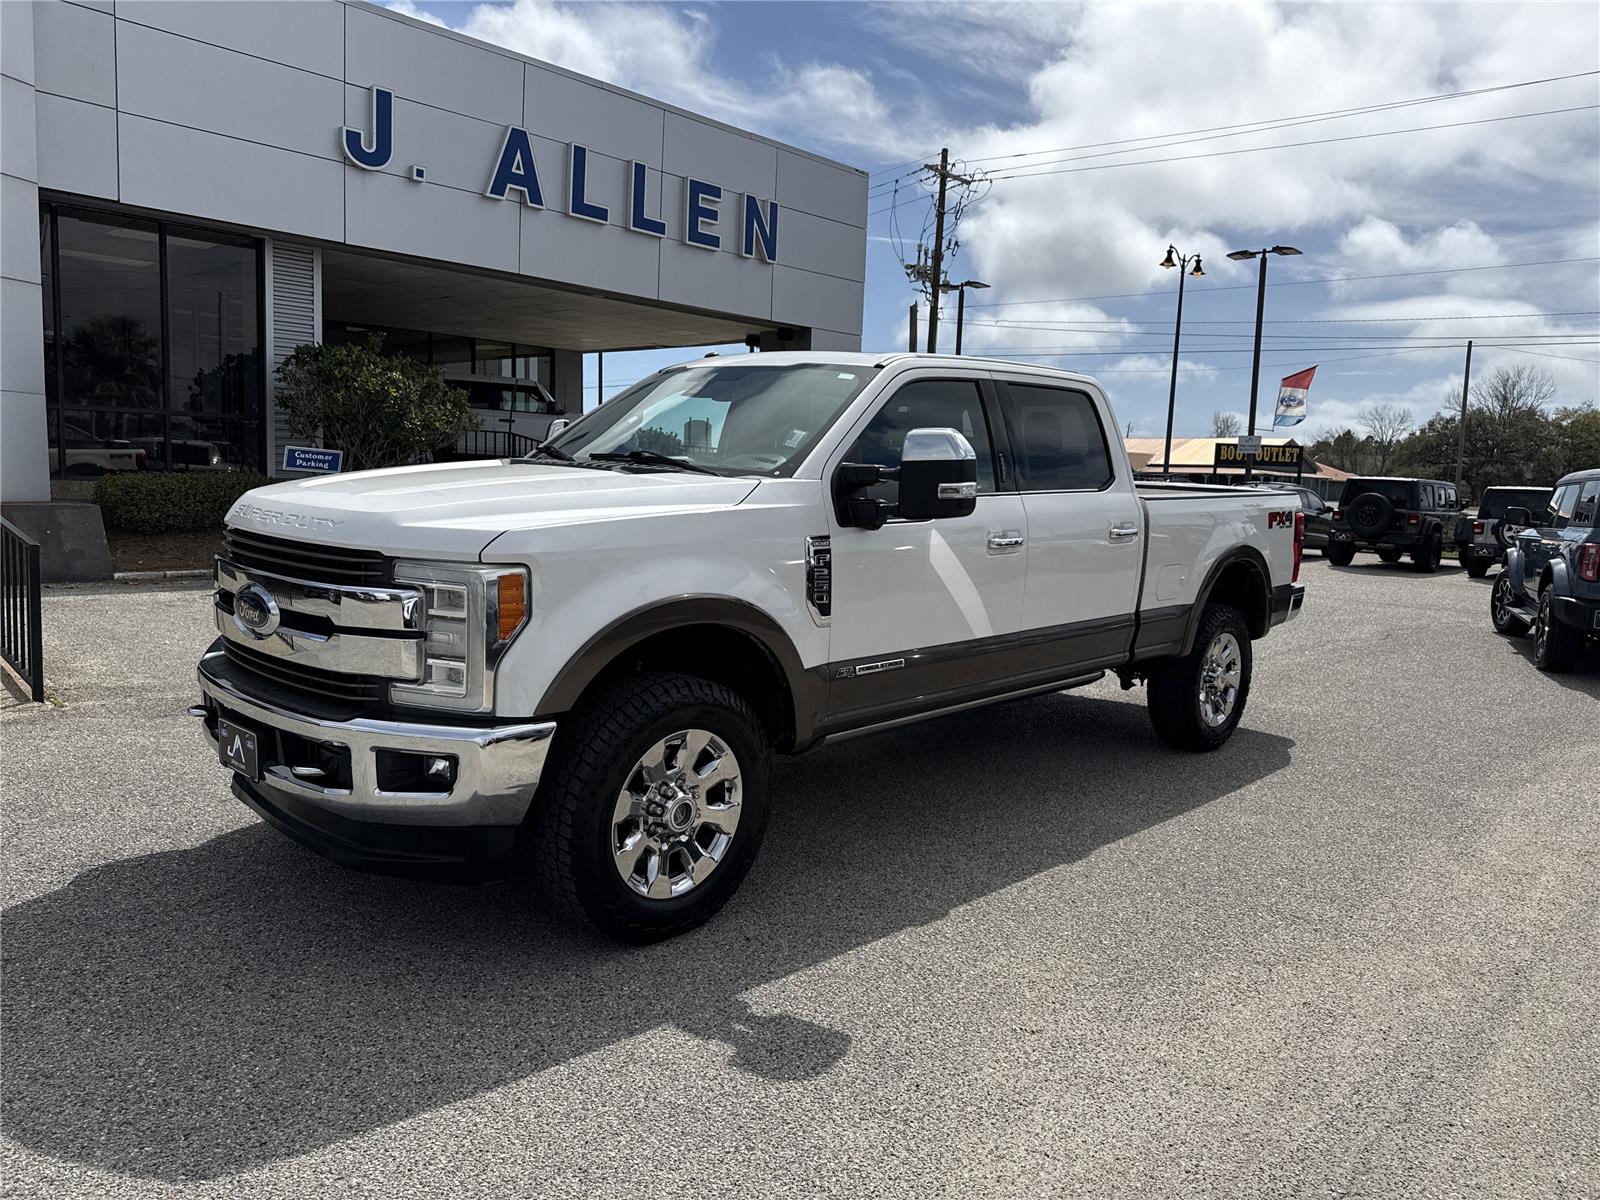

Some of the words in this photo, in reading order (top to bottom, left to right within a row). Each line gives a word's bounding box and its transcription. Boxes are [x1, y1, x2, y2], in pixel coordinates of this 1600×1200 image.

[483, 124, 781, 265] ALLEN
[294, 451, 333, 461] Customer
[1220, 445, 1248, 461] BOO
[296, 459, 329, 469] Parking
[235, 503, 284, 529] SUPER
[280, 513, 346, 533] DUTY
[1268, 510, 1293, 529] FX4
[240, 600, 260, 623] Ford
